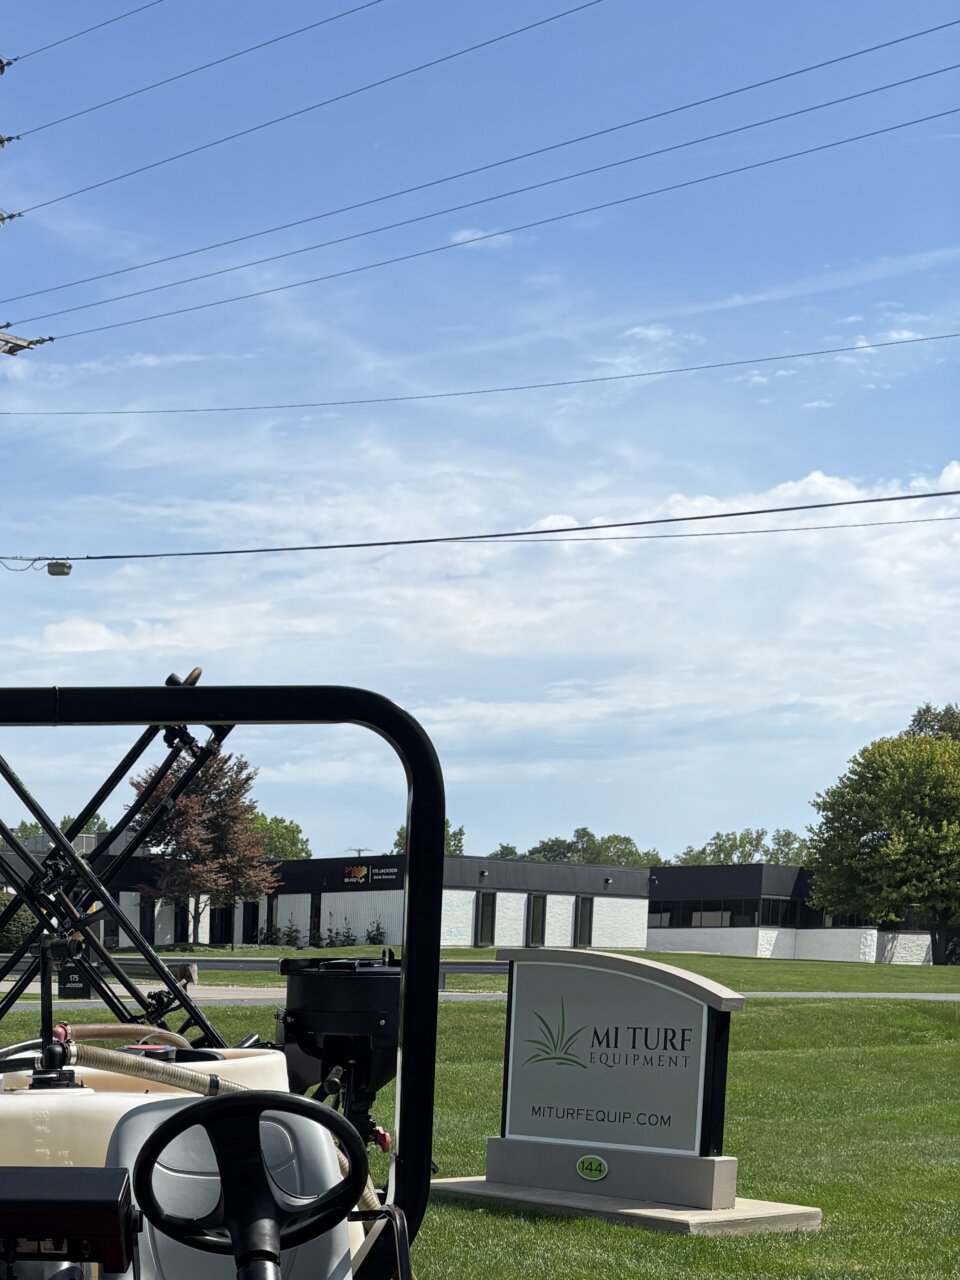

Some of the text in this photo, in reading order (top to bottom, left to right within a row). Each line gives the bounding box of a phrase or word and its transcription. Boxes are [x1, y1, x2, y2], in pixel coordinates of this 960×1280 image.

[591, 1026, 693, 1052] MI TURF
[590, 1052, 691, 1069] EQUIPMENT
[531, 1105, 672, 1128] MITURFEQUIP.COM
[581, 1160, 603, 1175] 144
